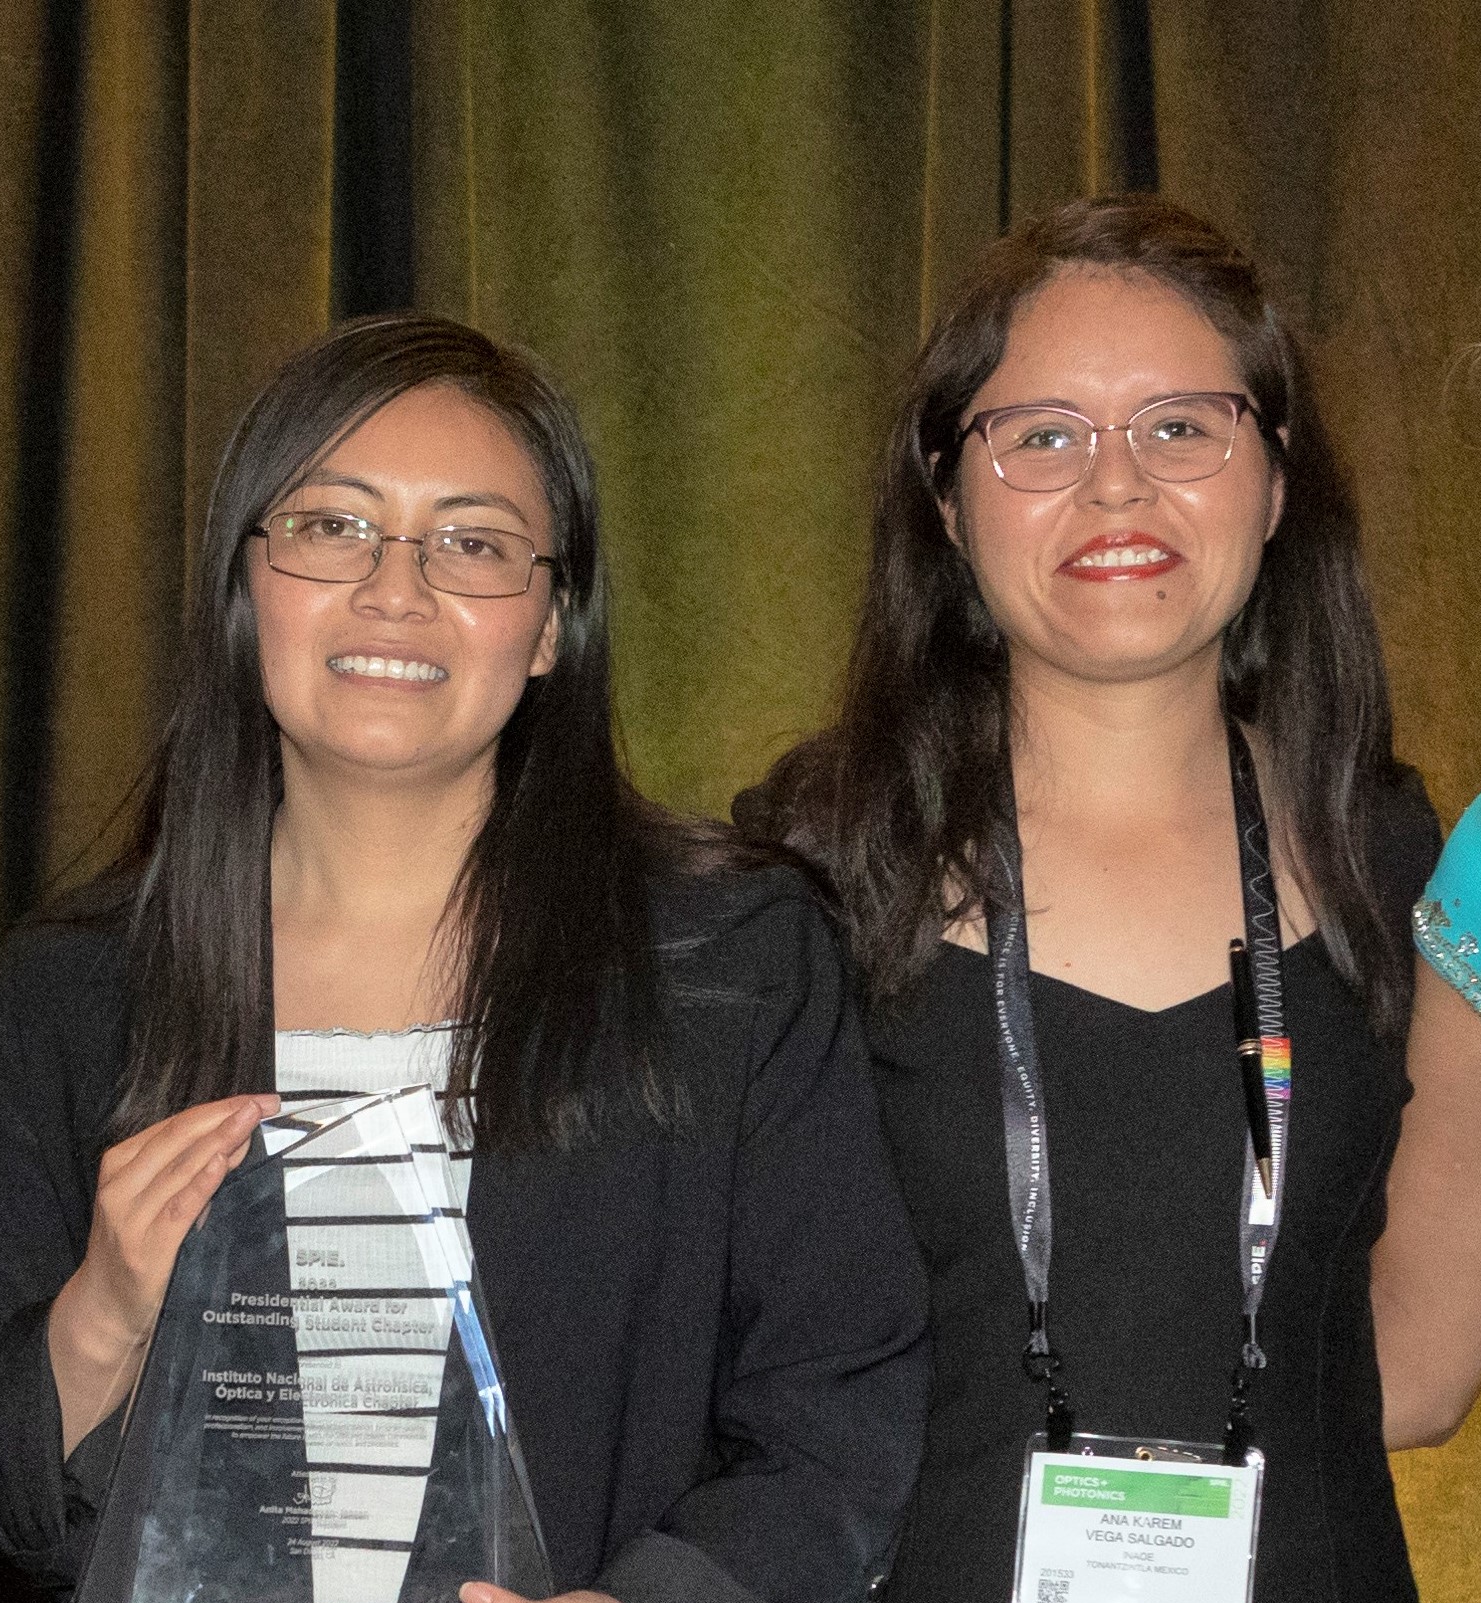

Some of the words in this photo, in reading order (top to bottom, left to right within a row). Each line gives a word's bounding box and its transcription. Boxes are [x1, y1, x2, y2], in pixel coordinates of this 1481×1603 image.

[995, 973, 1004, 996] FOR
[1030, 1115, 1040, 1183] DIVERSITY.
[231, 1292, 324, 1313] Presidential
[328, 1297, 380, 1314] Award
[385, 1299, 409, 1314] for
[202, 1310, 300, 1331] Outstanding
[305, 1314, 367, 1333] Student
[371, 1319, 436, 1336] Chapter
[202, 1369, 262, 1384] Instituto
[266, 1372, 327, 1393] Nacional
[331, 1378, 349, 1392] de
[215, 1384, 263, 1401] Óptica
[266, 1390, 275, 1402] y
[362, 1396, 420, 1411] Chapter
[1054, 1474, 1108, 1487] OPTICS+
[1053, 1486, 1126, 1501] PHOTONICS
[1100, 1513, 1129, 1527] ANA
[1133, 1515, 1182, 1530] KAREM
[1086, 1528, 1123, 1543] VEGA
[1127, 1531, 1195, 1549] SALGADO
